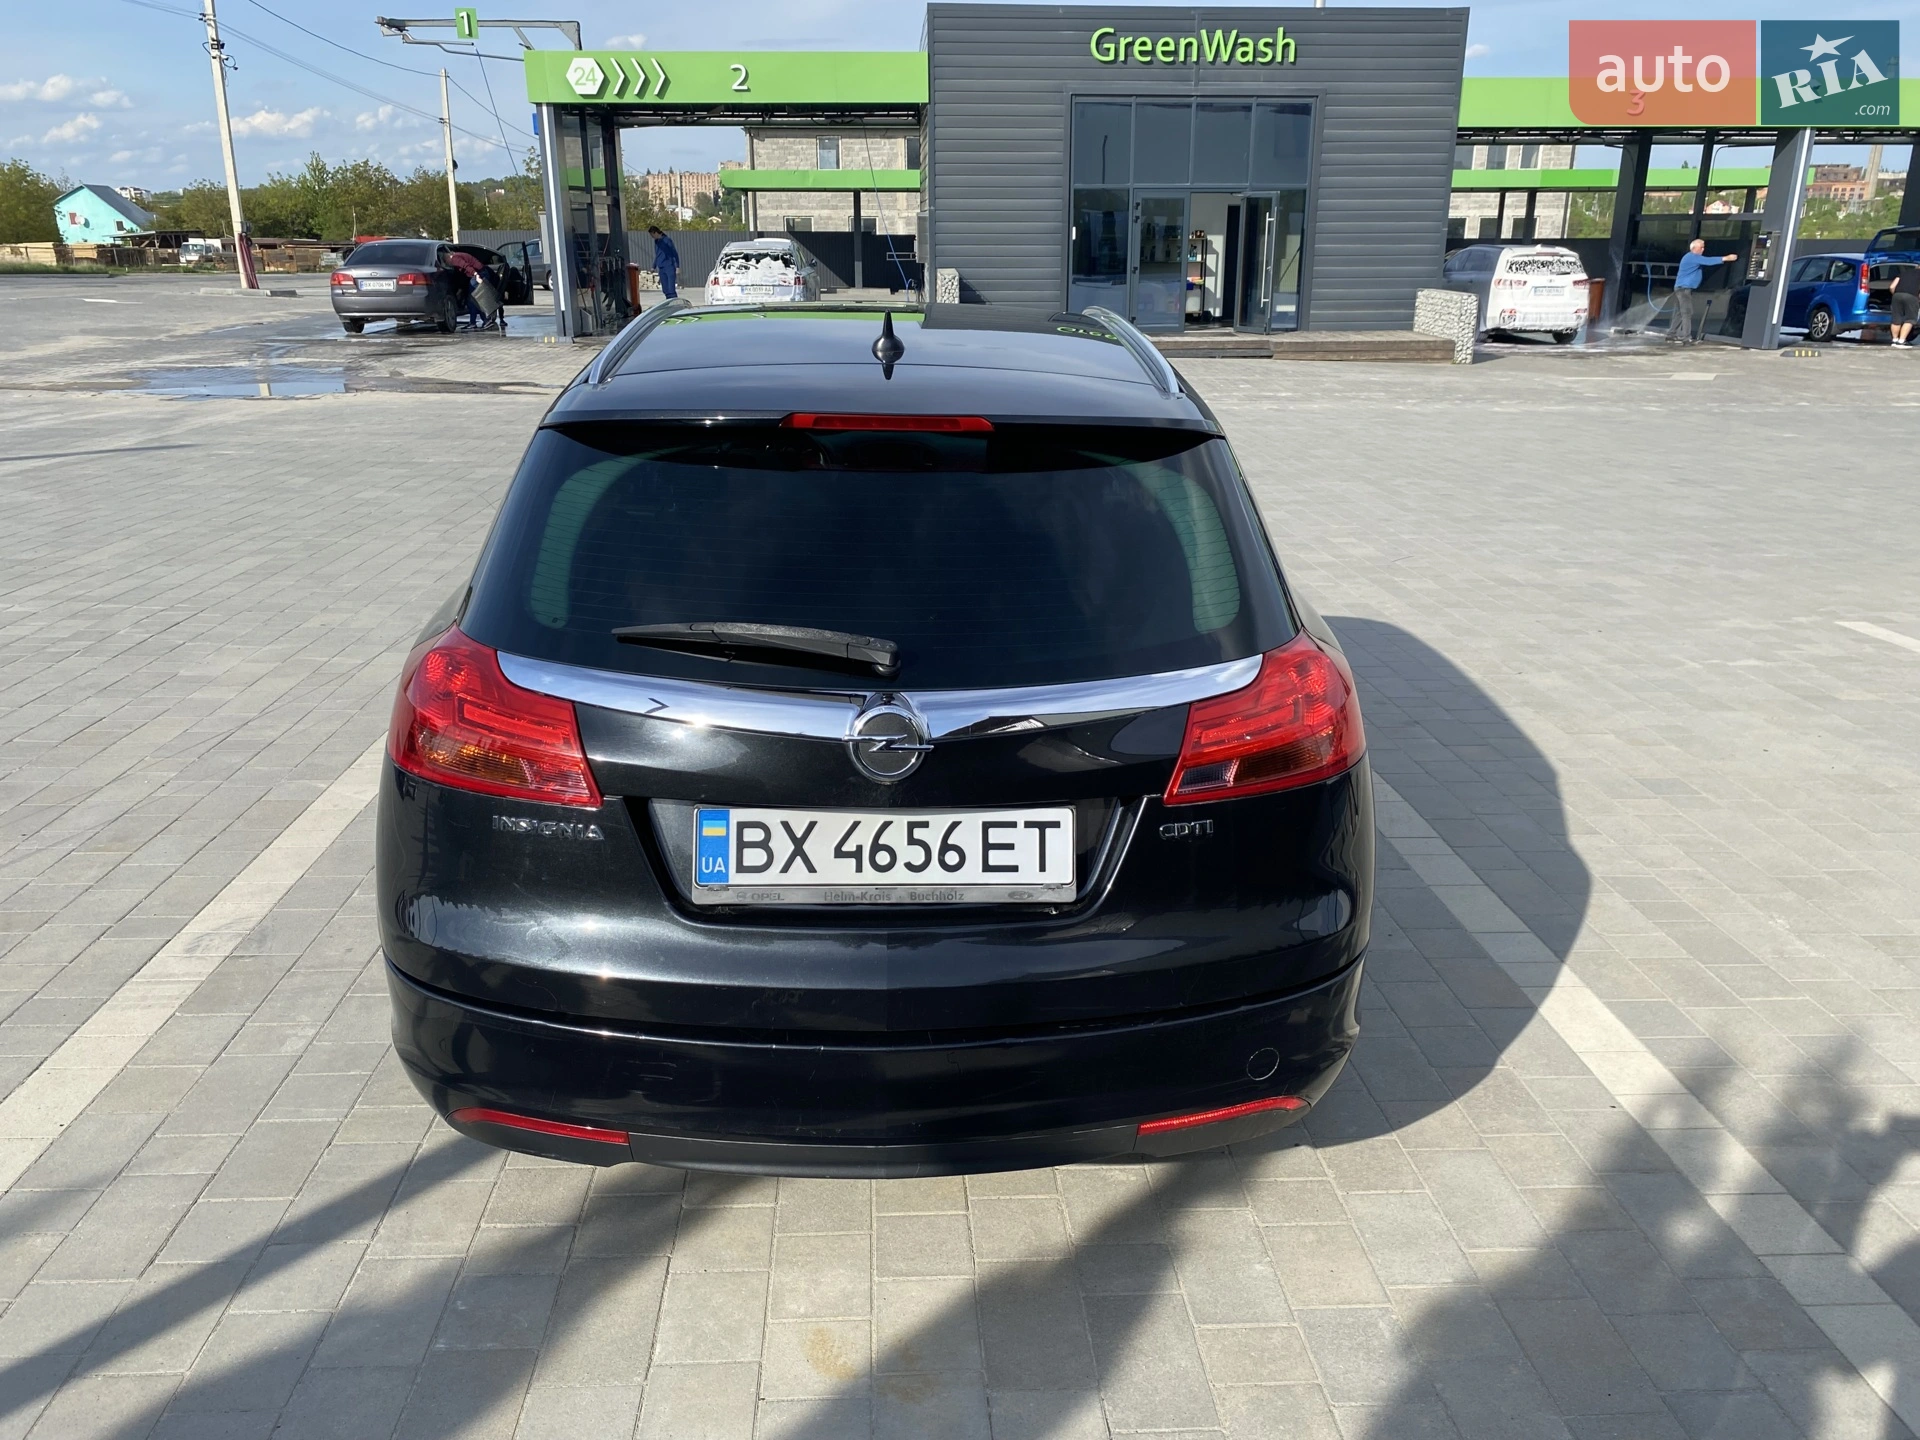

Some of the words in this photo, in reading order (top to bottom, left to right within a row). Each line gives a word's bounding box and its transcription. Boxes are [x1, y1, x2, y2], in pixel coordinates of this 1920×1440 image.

[459, 11, 470, 35] 1
[1090, 27, 1296, 63] GreenWash
[574, 66, 598, 86] 24
[730, 64, 749, 90] 2
[1626, 87, 1646, 116] 3
[492, 815, 605, 841] INSIGNIA
[1159, 819, 1214, 840] CDTI
[735, 820, 818, 873] BX
[834, 820, 966, 873] 4656
[981, 820, 1061, 873] ET
[701, 856, 726, 873] UA
[751, 892, 785, 901] OPEL
[909, 891, 965, 901] Buchholz
